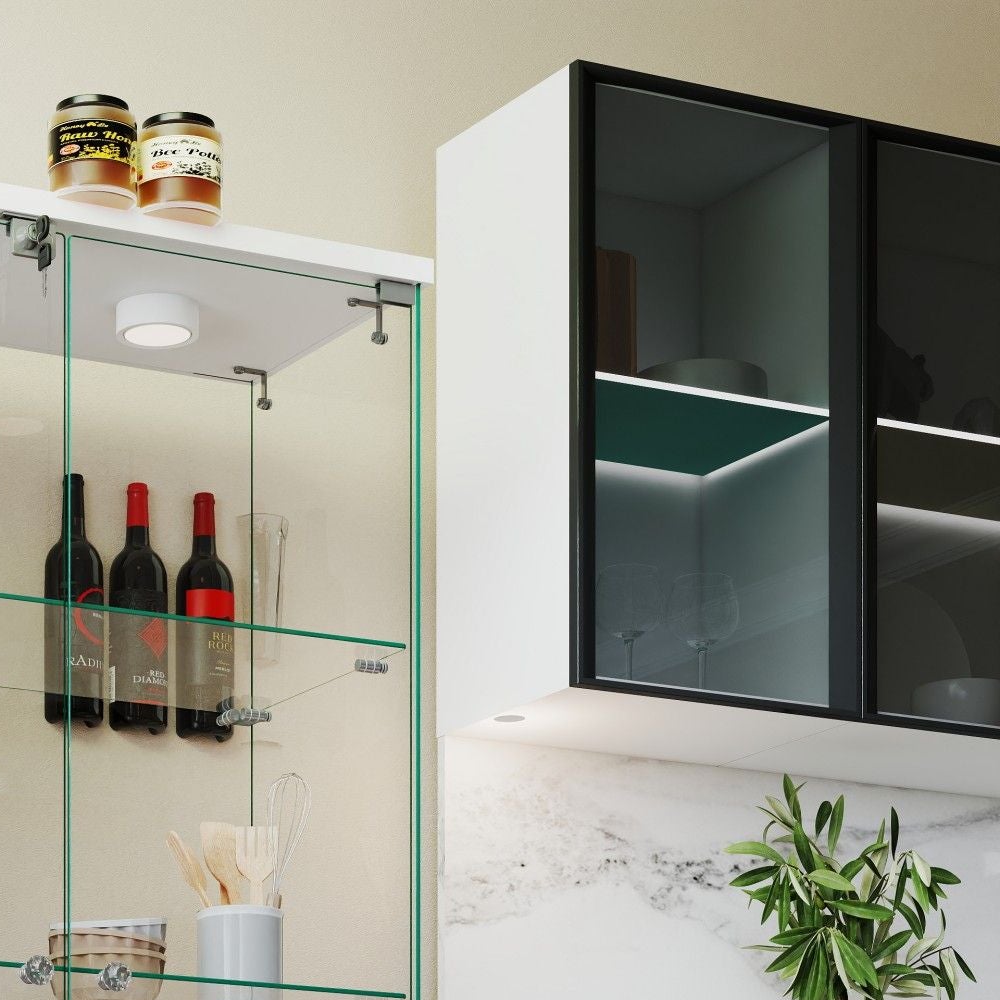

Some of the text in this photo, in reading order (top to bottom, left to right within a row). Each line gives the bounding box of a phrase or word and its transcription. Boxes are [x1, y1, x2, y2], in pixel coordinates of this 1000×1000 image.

[59, 131, 98, 142] Raw
[150, 148, 180, 158] Bee
[149, 669, 165, 679] RED
